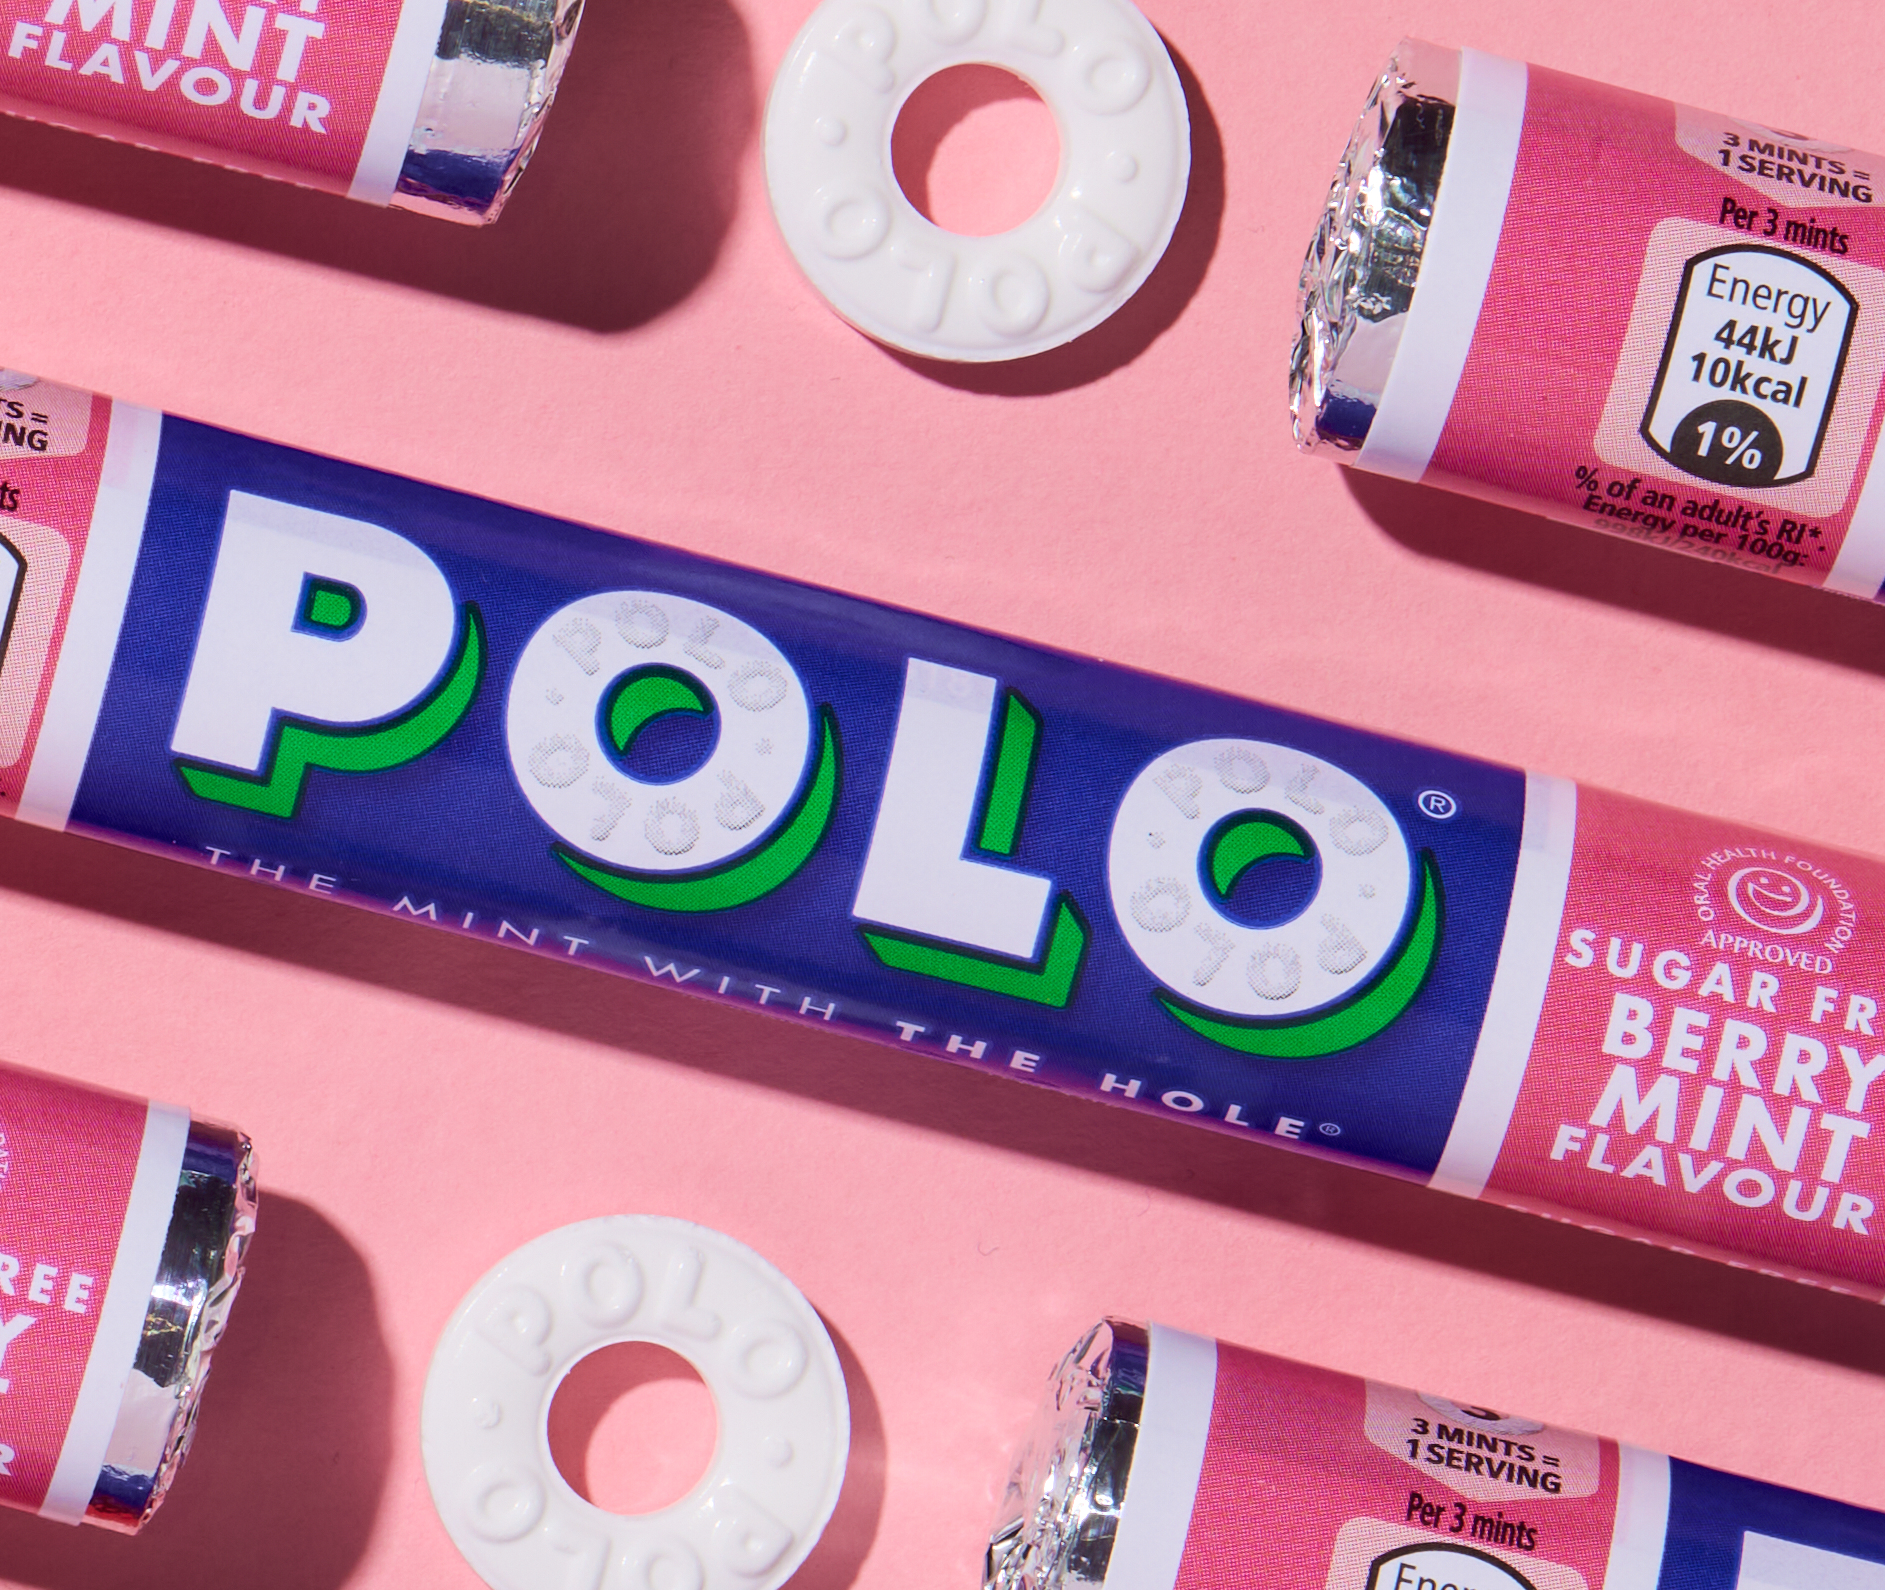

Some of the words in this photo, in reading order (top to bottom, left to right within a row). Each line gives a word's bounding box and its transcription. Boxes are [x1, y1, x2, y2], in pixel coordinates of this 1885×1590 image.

[8, 21, 331, 133] FLAVOUR
[1718, 149, 1731, 167] 1
[1738, 154, 1872, 204] SERVING
[1723, 133, 1740, 148] 3
[1747, 139, 1845, 175] MINTS
[1719, 196, 1759, 231] Per
[1763, 207, 1779, 237] 3
[1783, 217, 1849, 256] mints
[1706, 262, 1831, 334] Energy
[1714, 319, 1798, 365] 44kJ
[1691, 352, 1808, 409] 10kcal
[1697, 421, 1762, 469] 1%
[1574, 465, 1599, 497] %
[1606, 478, 1641, 501] of
[1640, 489, 1676, 513] an
[1582, 493, 1676, 534] Energy
[1678, 523, 1727, 545] per
[1700, 929, 1833, 975] APPROVED
[1564, 928, 1779, 1013] SUGAR
[1810, 986, 1877, 1036] FR
[1601, 992, 1885, 1113] BERRY
[1588, 1063, 1871, 1183] MINT
[1550, 1123, 1874, 1235] FLAVOUR
